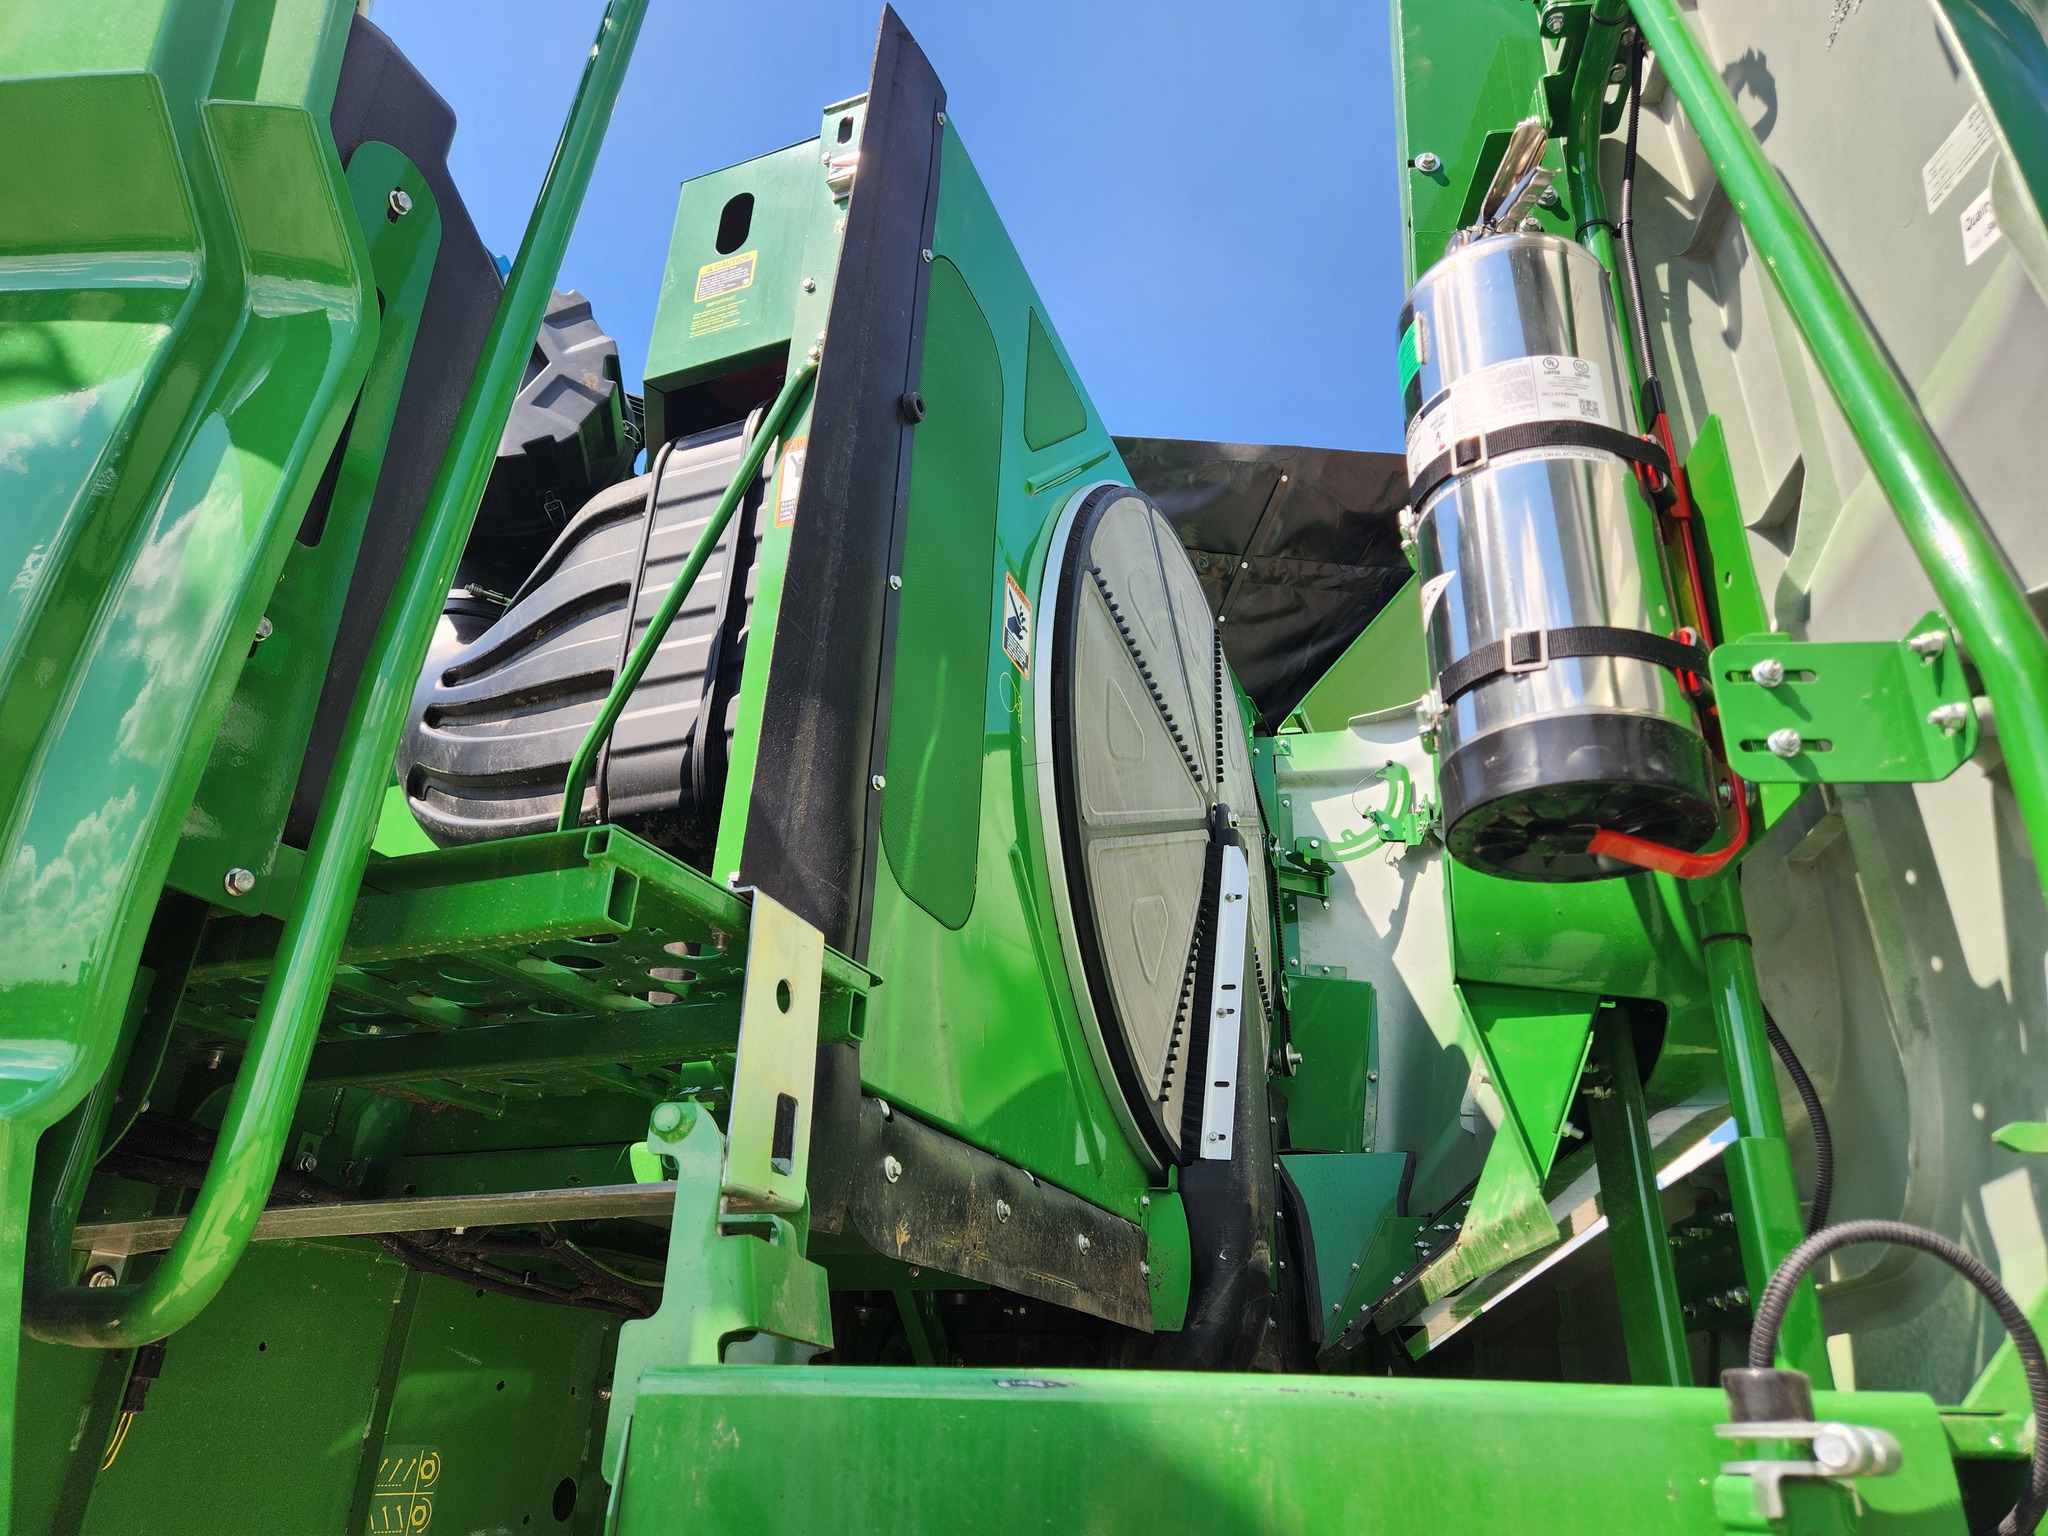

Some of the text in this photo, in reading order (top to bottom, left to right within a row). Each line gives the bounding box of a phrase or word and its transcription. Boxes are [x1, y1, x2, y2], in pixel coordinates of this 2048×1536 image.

[714, 254, 751, 270] CAUTION
[705, 294, 737, 308] IMPORTANT
[1010, 579, 1032, 612] WARNING
